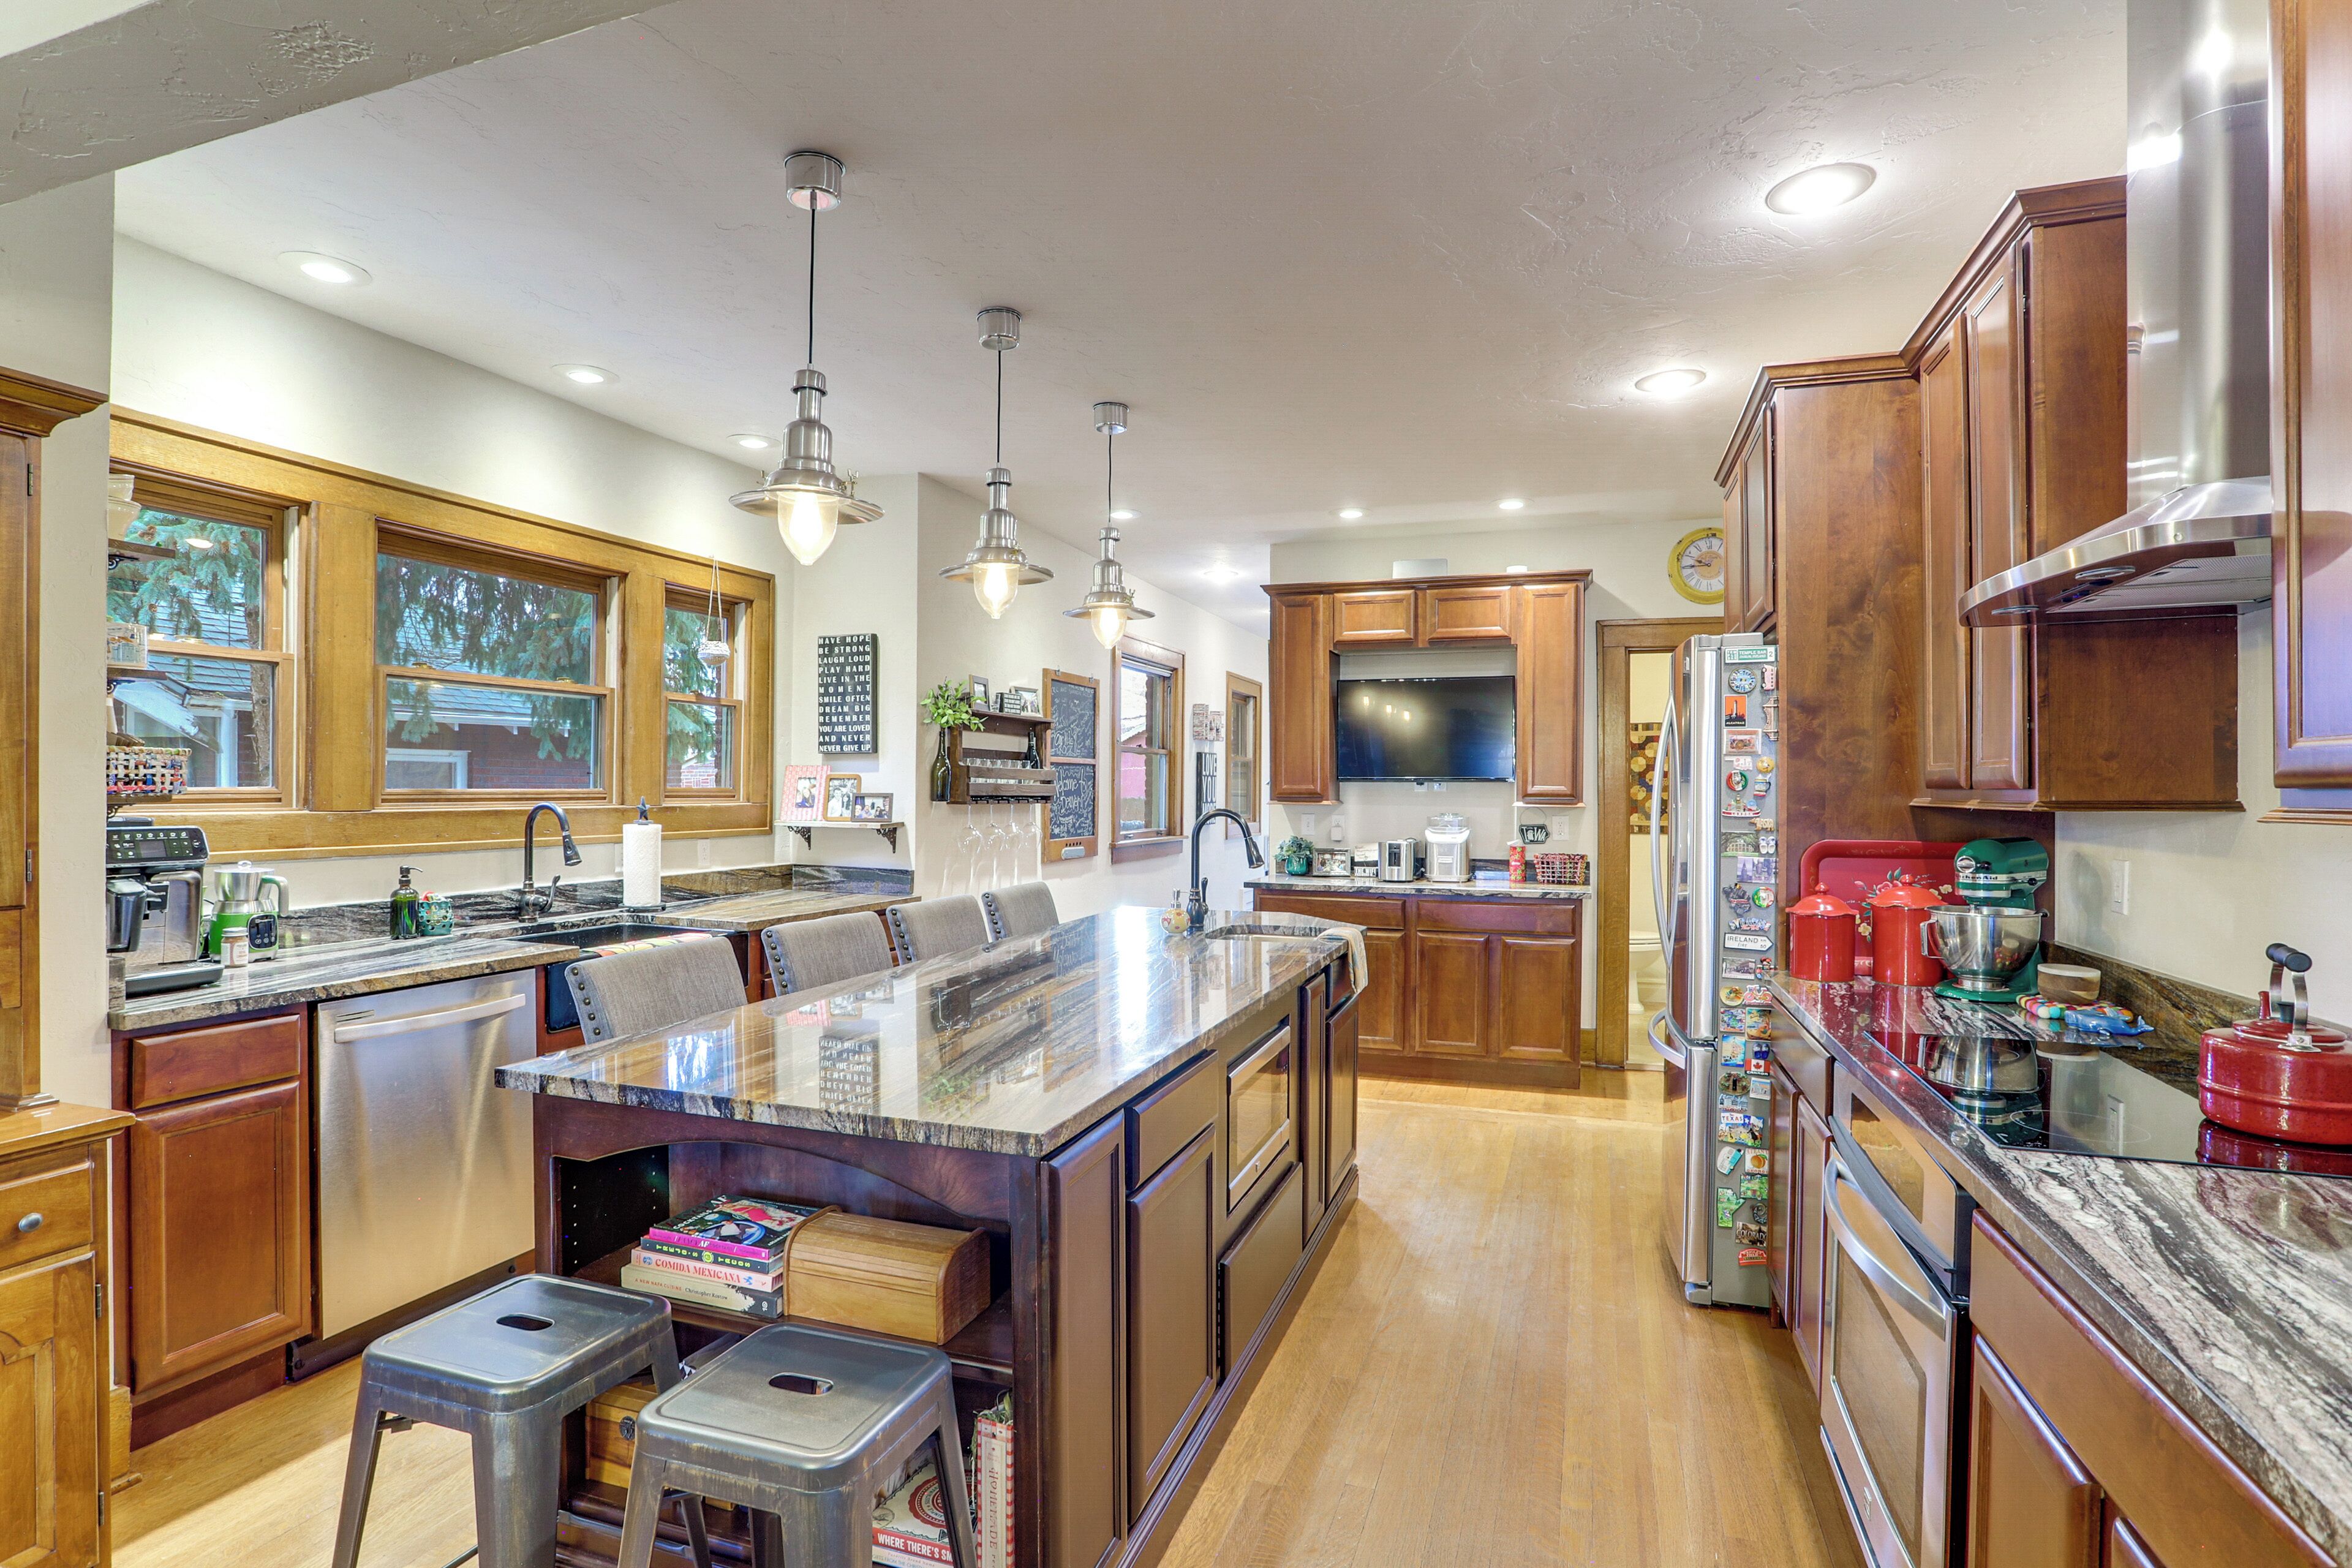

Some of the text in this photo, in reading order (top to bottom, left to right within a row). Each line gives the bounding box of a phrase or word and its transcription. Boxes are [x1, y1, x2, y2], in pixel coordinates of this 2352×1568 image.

[834, 645, 870, 654] STRONG
[819, 684, 870, 693] MOMENT
[1202, 753, 1217, 776] LOVE
[1054, 768, 1078, 797] Welcome
[1202, 776, 1216, 803] YOU
[673, 1210, 712, 1229] COCKTAILS
[655, 1258, 691, 1273] COMIDA
[693, 1265, 741, 1284] MEXICANA
[718, 1256, 751, 1268] TACOS
[685, 1287, 711, 1298] Christopher
[988, 1468, 999, 1550] HOMEMADE
[877, 1532, 953, 1562] WHERE THERE'S SM
